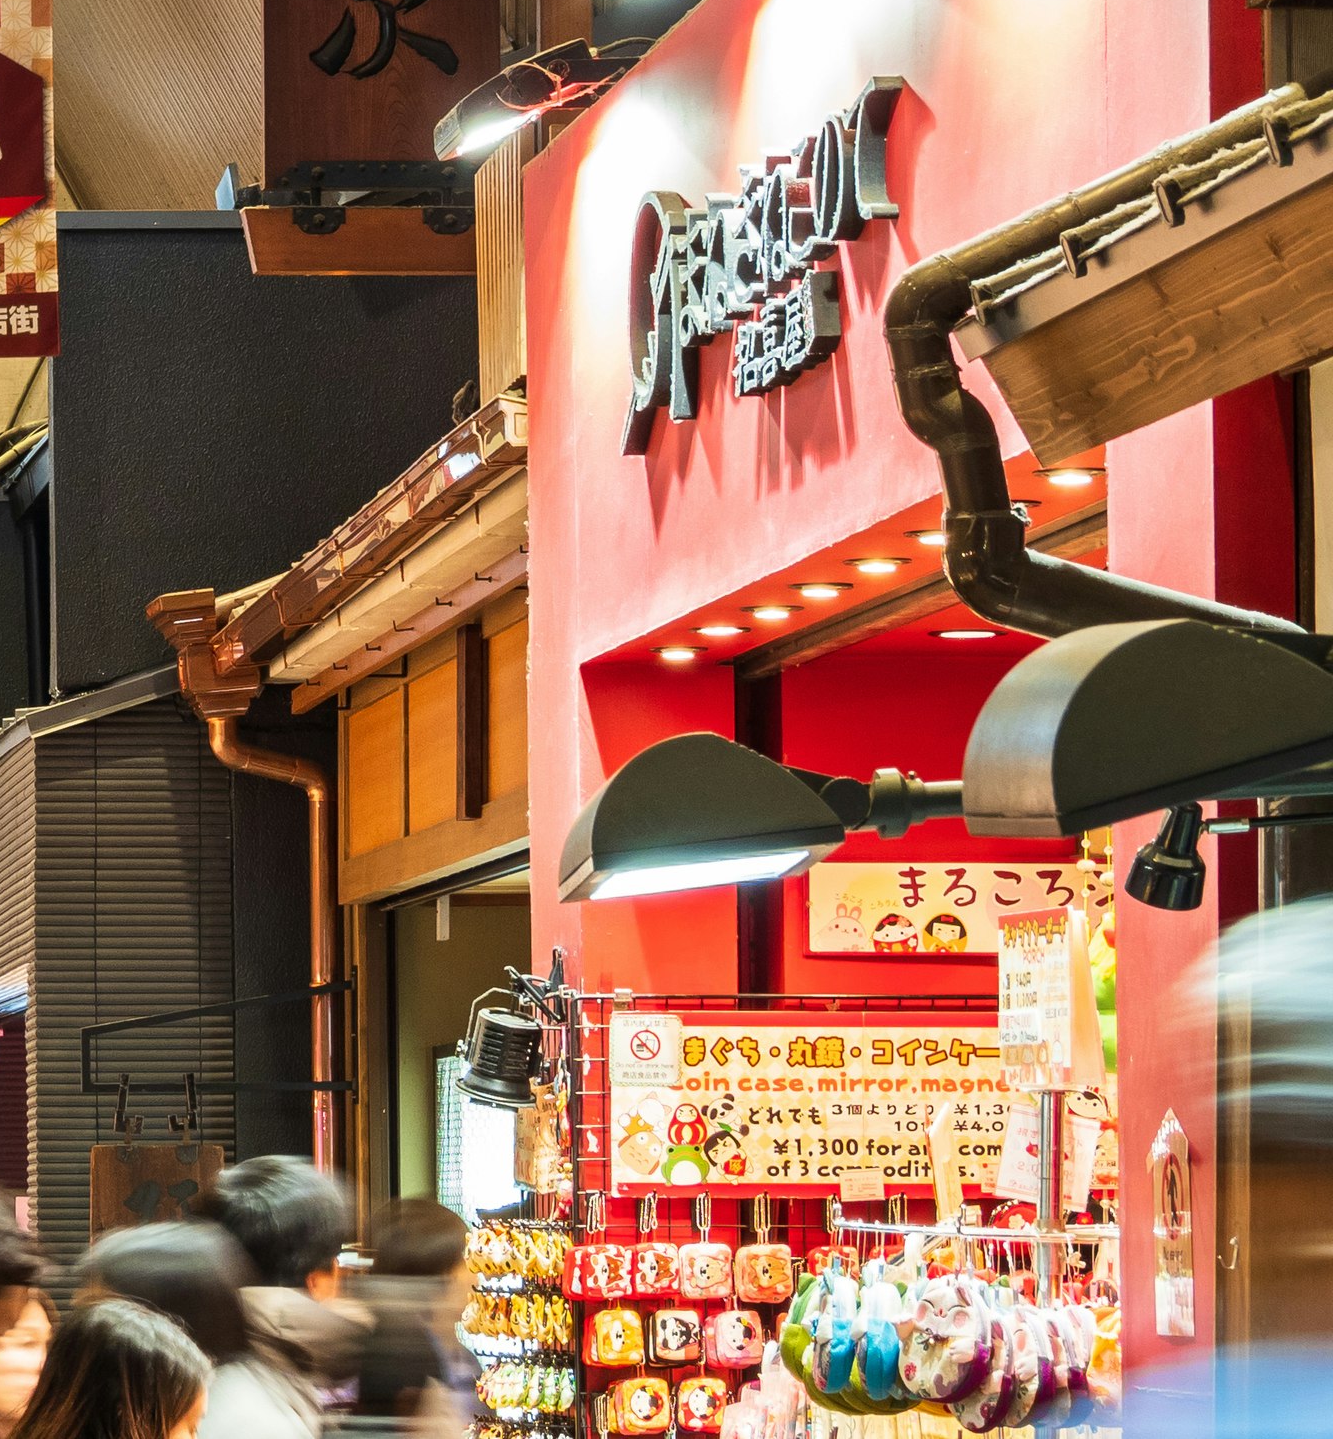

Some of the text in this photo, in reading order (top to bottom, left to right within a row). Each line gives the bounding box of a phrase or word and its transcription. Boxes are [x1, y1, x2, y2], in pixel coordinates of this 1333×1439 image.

[748, 1107, 823, 1126] どれでも
[773, 1138, 859, 1159] ¥1,300
[865, 1138, 902, 1156] for
[767, 1160, 792, 1179] of
[801, 1160, 810, 1178] 3
